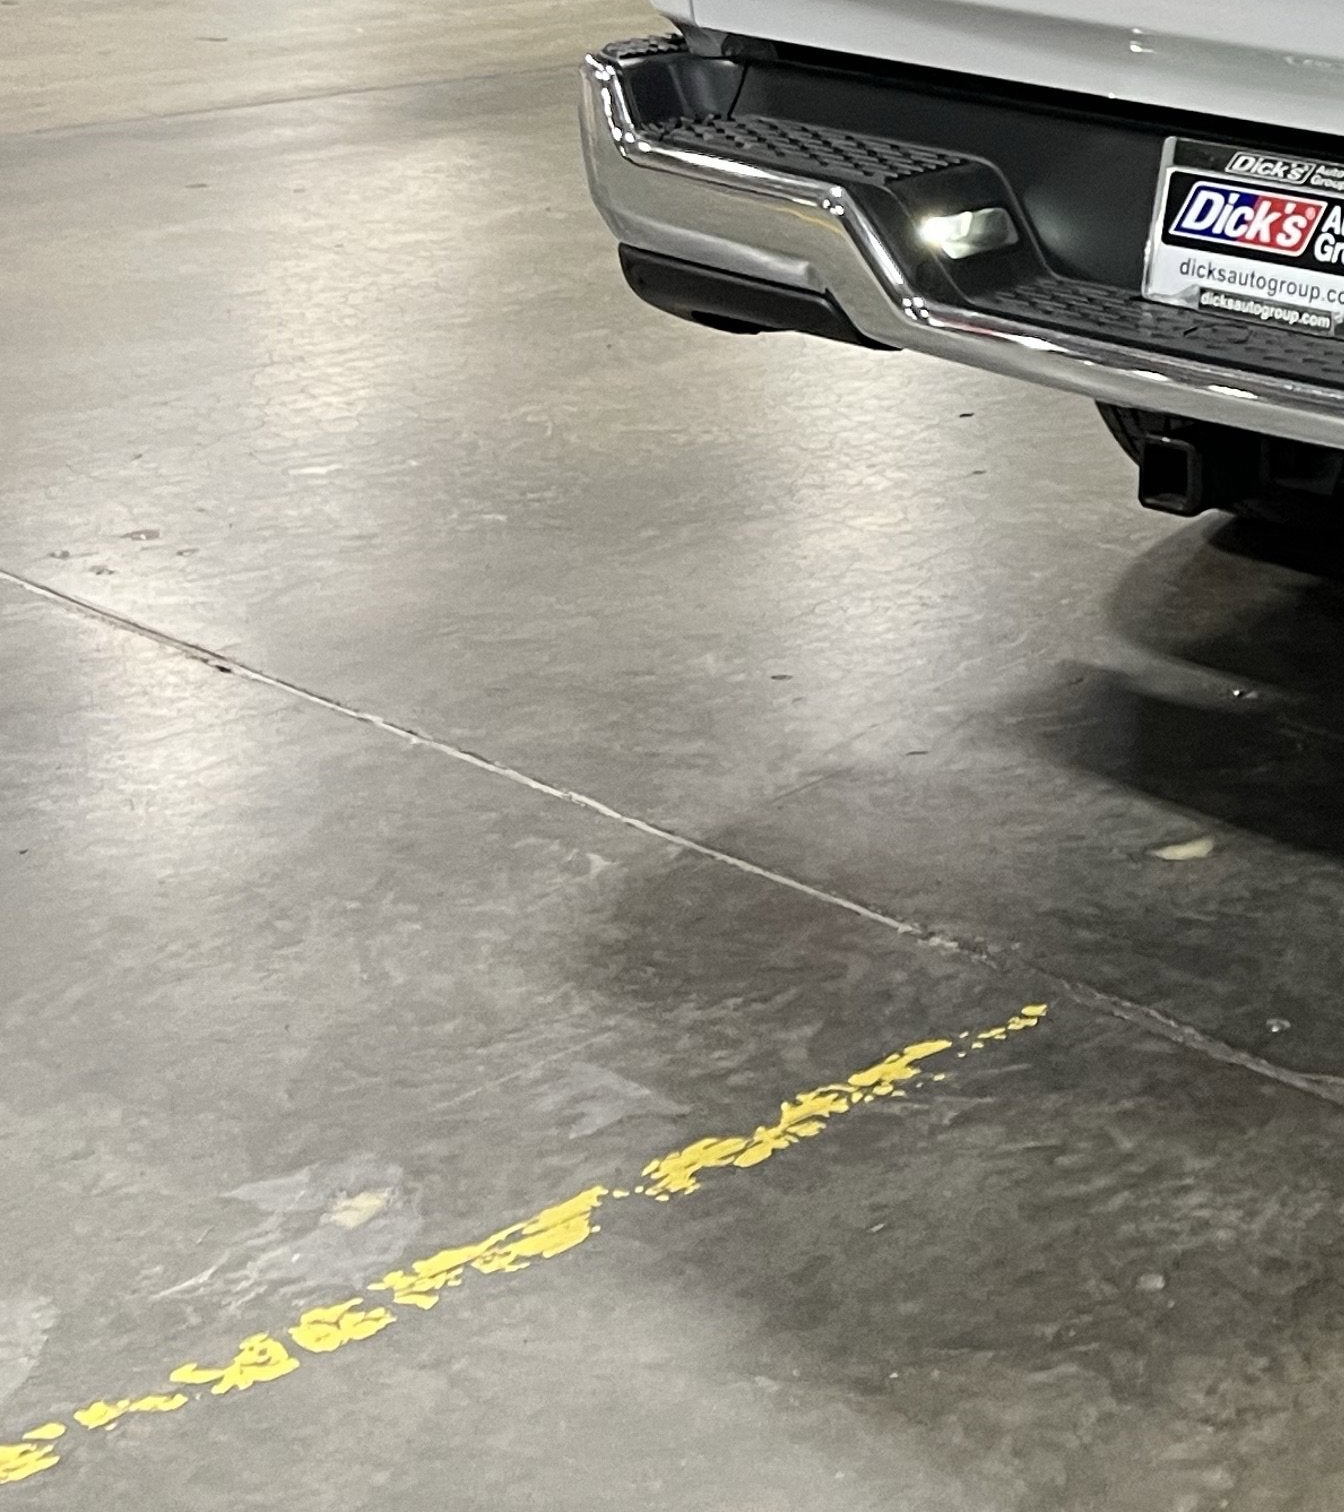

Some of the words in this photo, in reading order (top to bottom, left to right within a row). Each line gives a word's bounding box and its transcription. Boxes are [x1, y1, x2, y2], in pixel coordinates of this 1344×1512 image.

[1231, 155, 1309, 182] Dick's
[1181, 190, 1309, 248] Dick's
[1199, 291, 1331, 329] dicksautogroup.com
